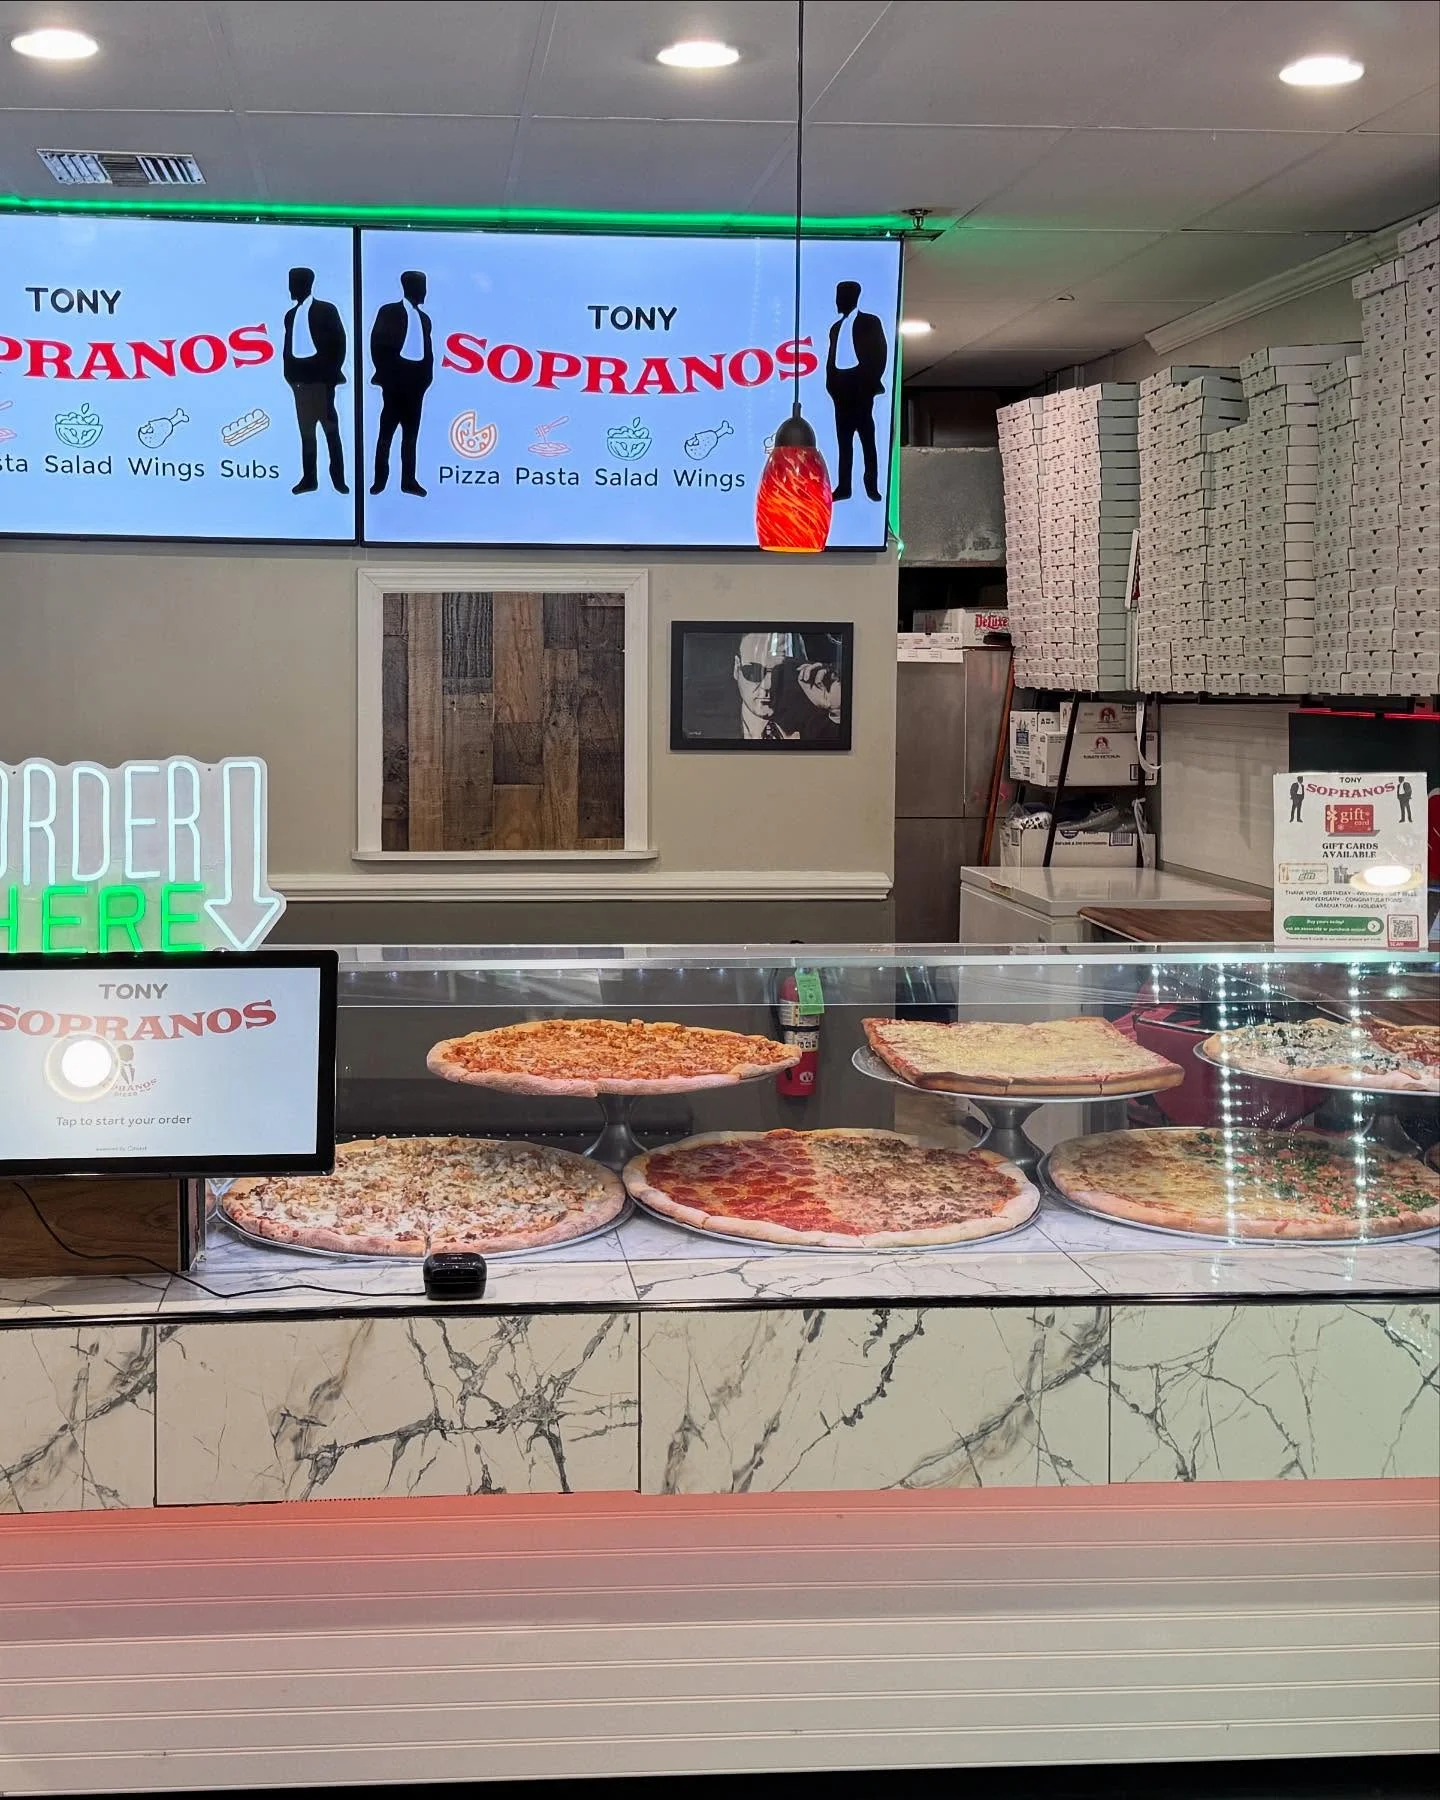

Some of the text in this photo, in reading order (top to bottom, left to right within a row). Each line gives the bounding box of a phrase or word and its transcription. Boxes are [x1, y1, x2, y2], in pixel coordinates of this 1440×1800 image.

[25, 286, 122, 315] TONY
[587, 305, 678, 332] TONY
[441, 332, 819, 395] SOPRANOS
[45, 455, 112, 476] Salad
[128, 457, 205, 483] Wings
[220, 459, 280, 480] Subs
[438, 466, 745, 494] Pizza Pasta Salad Wings
[1306, 782, 1396, 798] SOPRANOS
[0, 760, 201, 886] RDER
[1340, 807, 1366, 823] gift
[1322, 842, 1379, 850] GIFT CARDS
[98, 983, 169, 1000] TONY
[0, 999, 278, 1041] SOPRANOS
[56, 1114, 192, 1128] Tap to start your order
